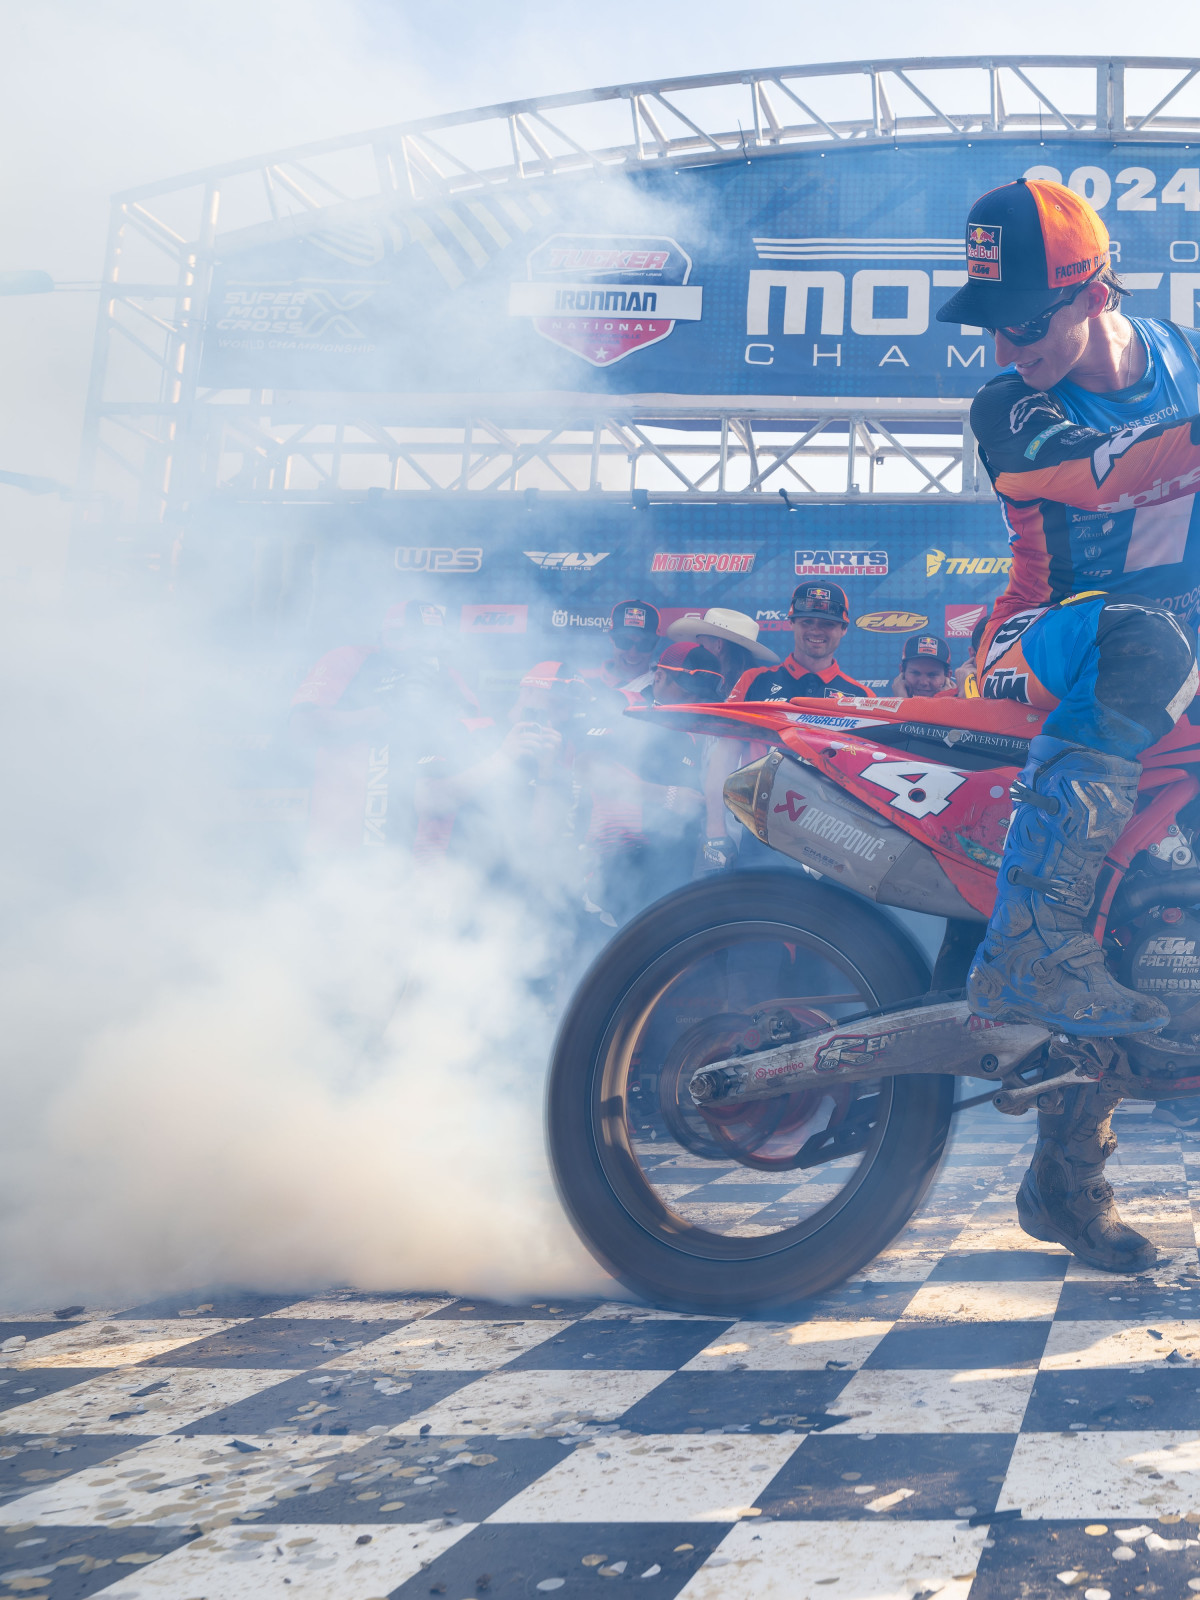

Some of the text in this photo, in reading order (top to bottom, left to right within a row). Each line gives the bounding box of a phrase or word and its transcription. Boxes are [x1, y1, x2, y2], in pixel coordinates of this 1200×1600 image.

[550, 249, 670, 269] TUCKER
[979, 246, 998, 260] Bull
[972, 264, 990, 275] KTM
[1055, 258, 1091, 279] FACTORY
[224, 291, 307, 305] SUPER
[555, 290, 657, 312] IRONMAN
[226, 306, 303, 320] MOTO
[216, 319, 304, 334] CROSS
[552, 322, 656, 332] NATIONAL
[268, 340, 377, 353] CHAMPIONSHIP
[1110, 404, 1179, 433] CHASE SEXTON
[395, 548, 484, 573] WPS
[523, 551, 611, 567] FLY
[795, 551, 888, 566] PARTS
[945, 557, 1012, 574] THOR
[795, 565, 888, 575] UNLIMITED
[471, 611, 516, 626] KTM
[570, 615, 613, 628] Husqva
[755, 610, 780, 621] MX
[857, 613, 929, 629] FMF
[983, 667, 1033, 706] KTM
[797, 713, 859, 729] PROGRESSIVE
[899, 723, 926, 736] LOMA
[926, 727, 951, 740] LIND
[1011, 740, 1031, 751] HEA
[858, 761, 969, 820] 4
[1145, 936, 1196, 954] KTM
[767, 1060, 804, 1077] brembo
